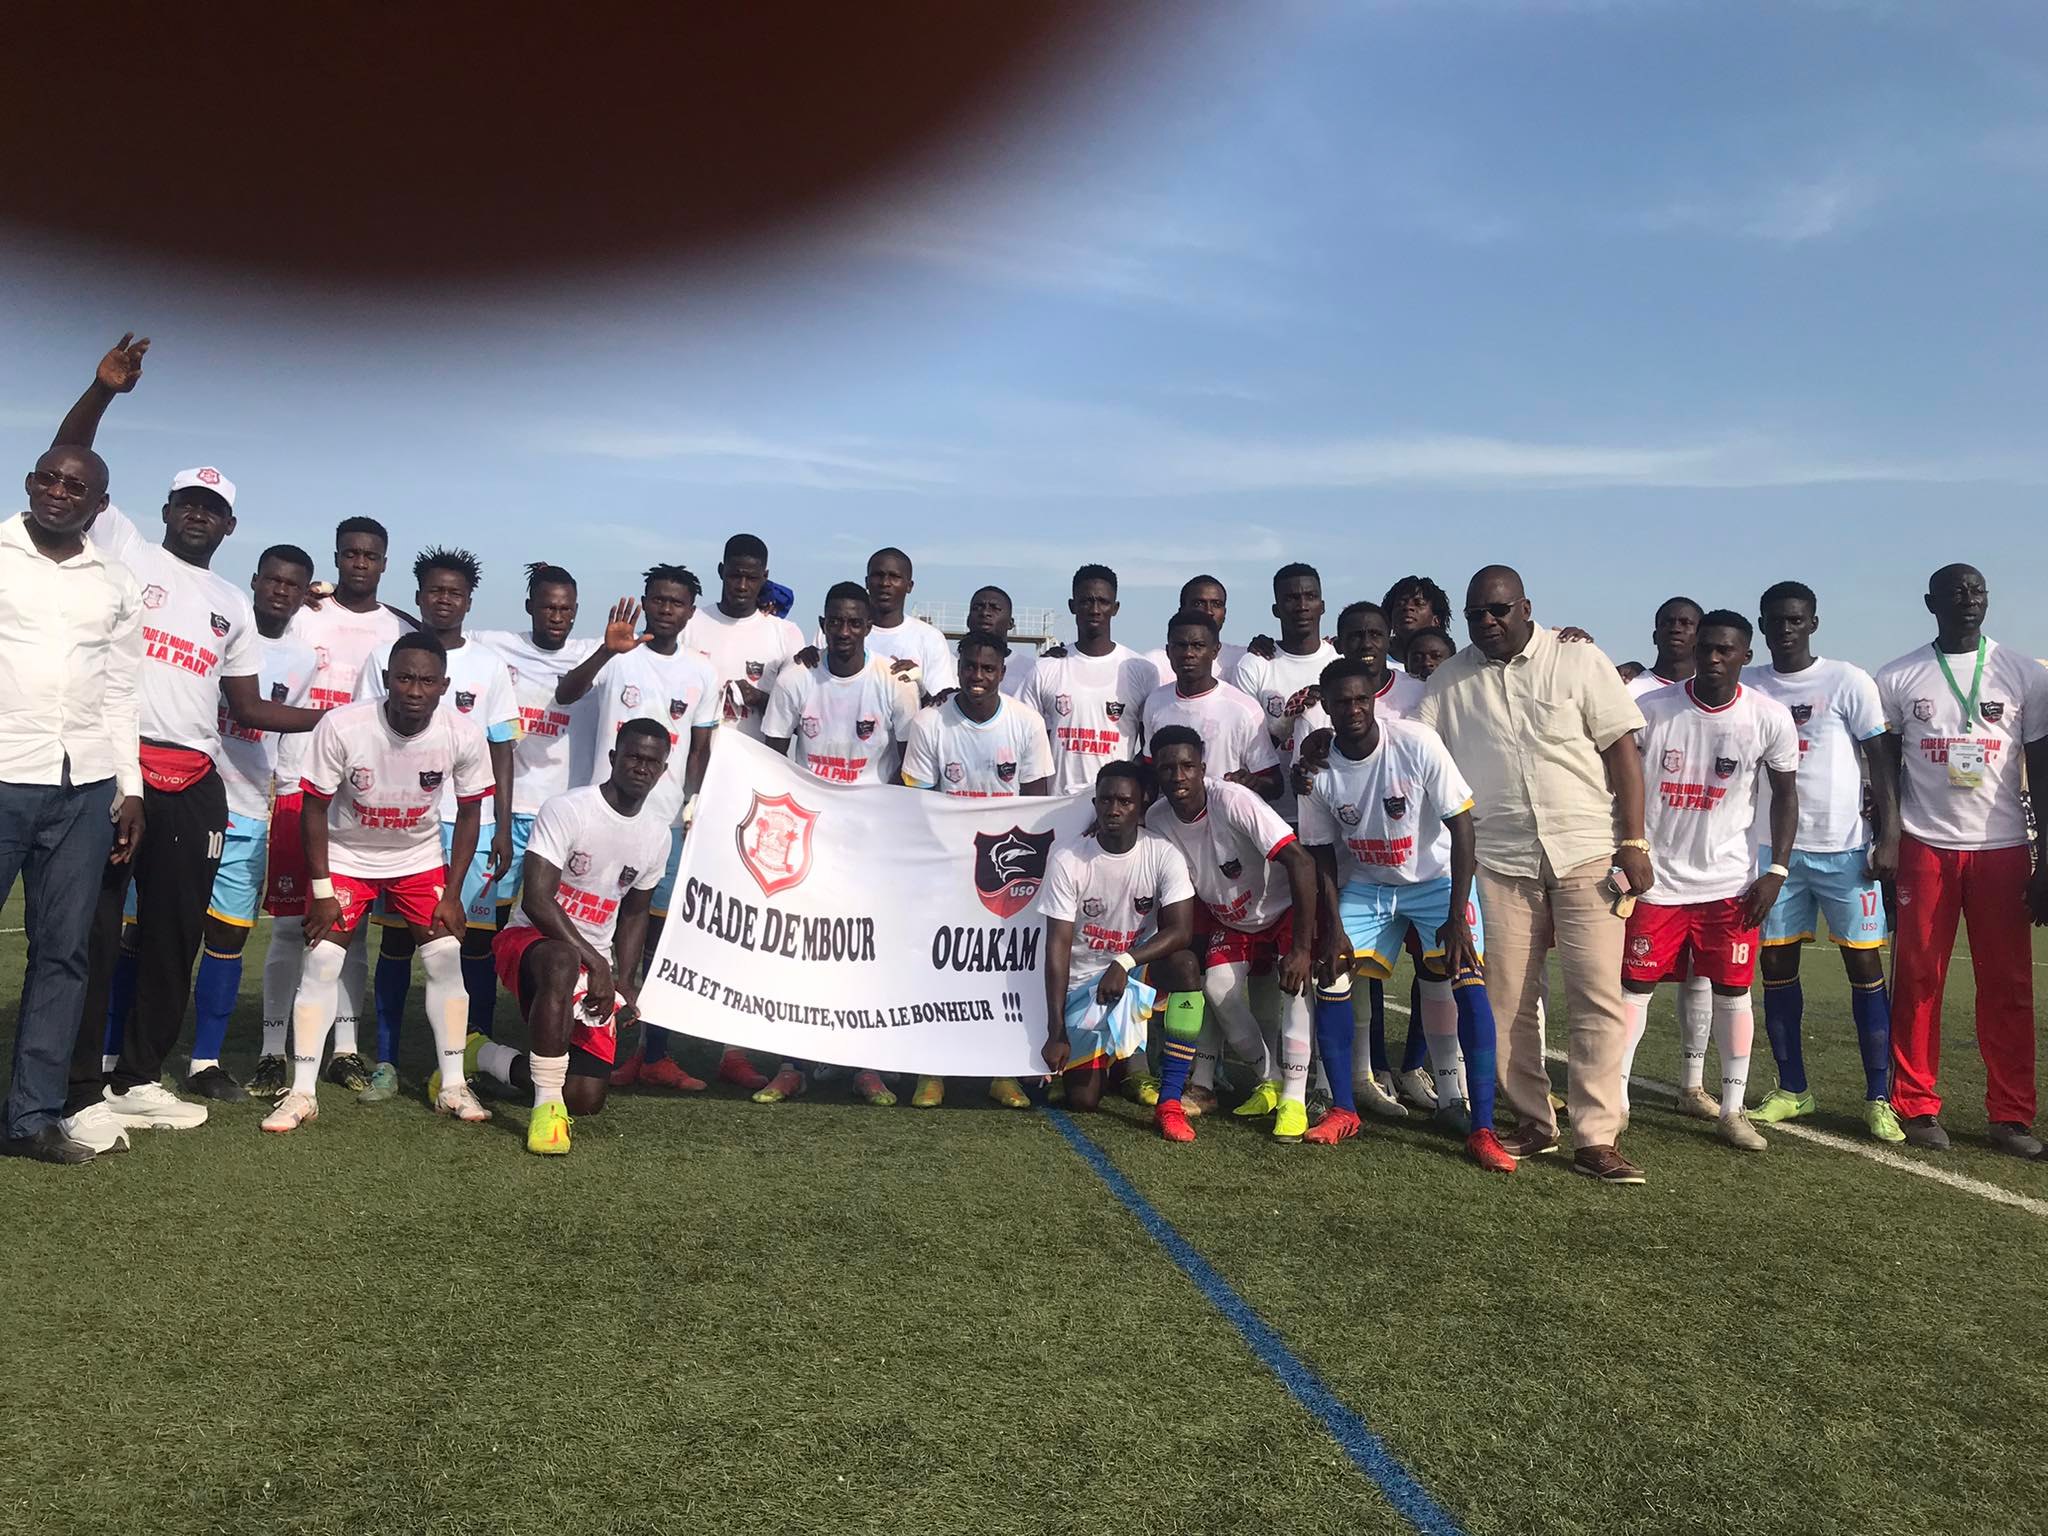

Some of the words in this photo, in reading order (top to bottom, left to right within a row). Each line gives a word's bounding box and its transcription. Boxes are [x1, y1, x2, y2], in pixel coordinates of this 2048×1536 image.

[143, 626, 160, 642] TADE
[146, 643, 169, 660] LA
[171, 650, 209, 677] PAIX
[528, 719, 559, 737] PAIX
[1066, 739, 1080, 751] LA
[1081, 740, 1111, 754] PAIX
[1931, 750, 1948, 763] LA
[815, 764, 829, 778] LA
[1669, 795, 1683, 807] LA
[361, 815, 379, 828] LA
[207, 831, 223, 859] 10
[1009, 885, 1035, 897] USO
[1860, 891, 1877, 917] 17
[682, 877, 758, 951] STADE
[760, 908, 801, 959] DE
[802, 917, 876, 962] MBOUR
[931, 925, 1041, 972] OUAKAM
[1732, 942, 1750, 964] 18
[657, 958, 698, 992] PAIX
[697, 976, 721, 1000] ET
[889, 1006, 909, 1027] LE
[911, 999, 995, 1024] BONHEUR
